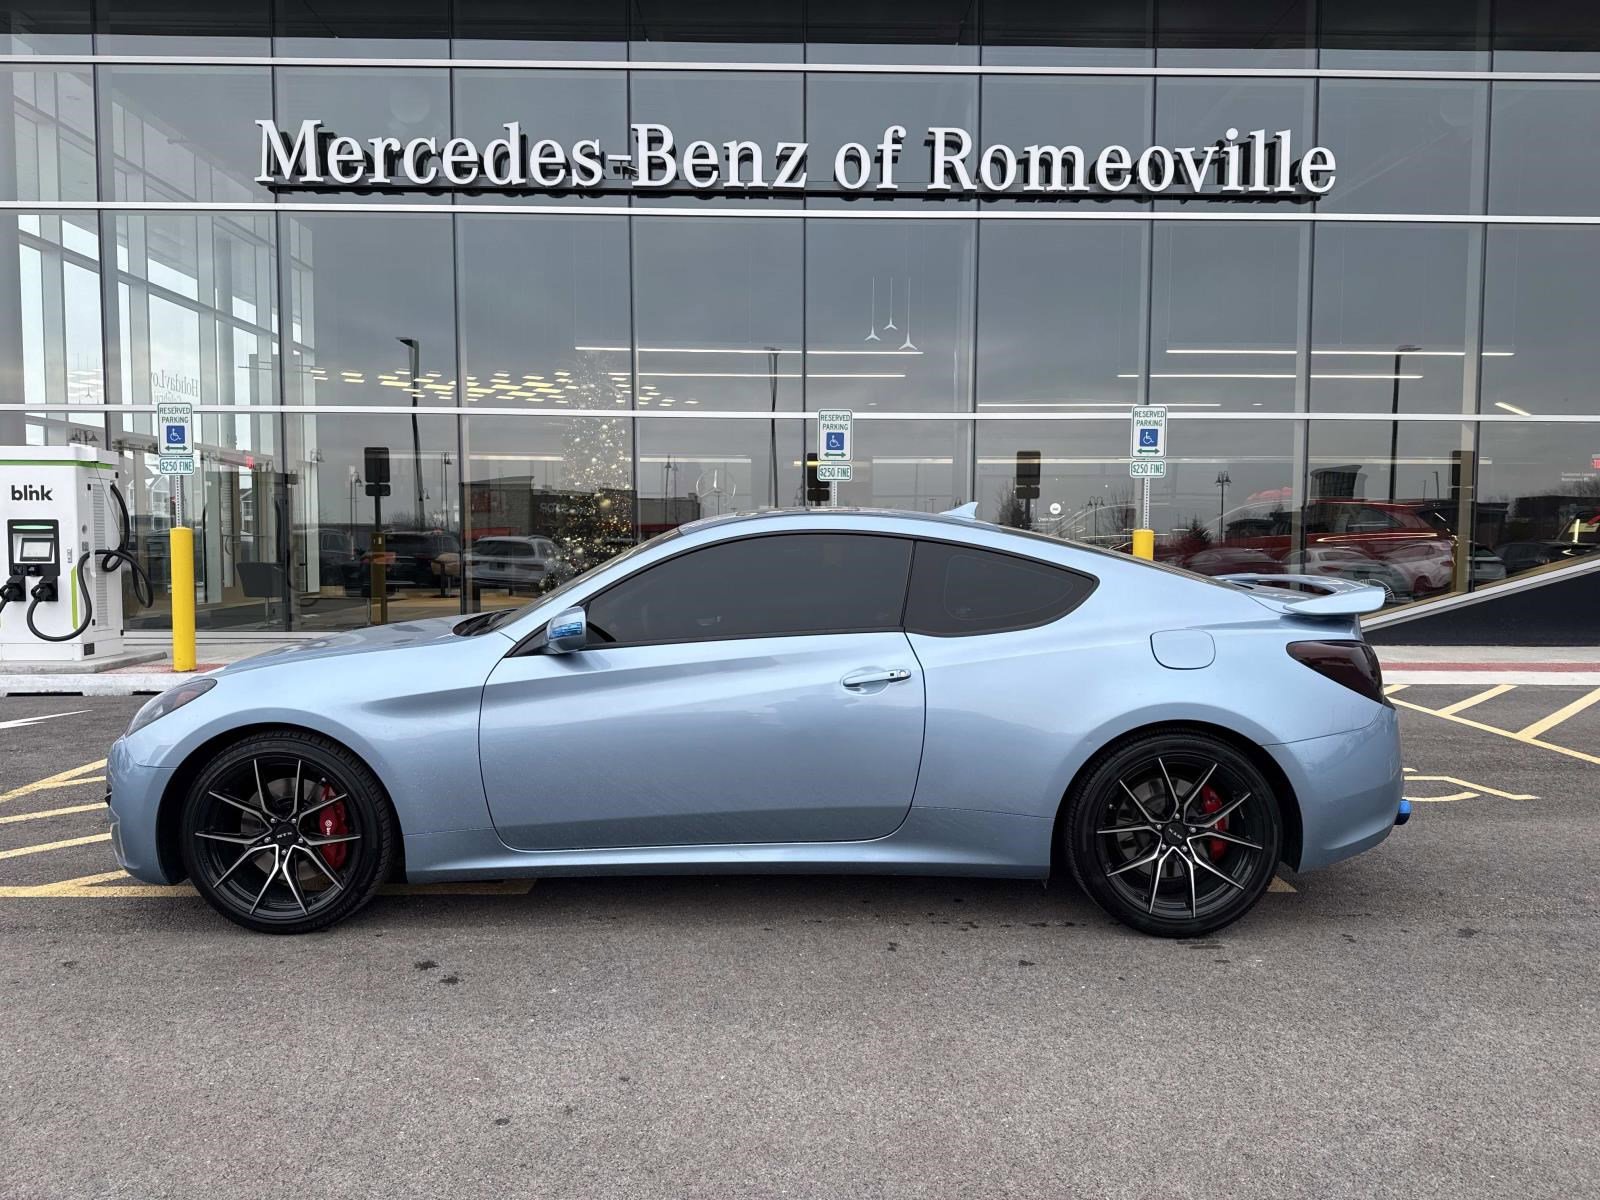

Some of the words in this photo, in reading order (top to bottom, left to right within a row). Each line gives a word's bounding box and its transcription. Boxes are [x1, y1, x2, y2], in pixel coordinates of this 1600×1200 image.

[253, 119, 809, 189] Mercedes-Benz
[834, 125, 907, 191] of
[927, 127, 1337, 193] Romeoville
[159, 407, 191, 415] RESERVED
[1134, 410, 1165, 418] RESERVED
[161, 416, 189, 424] PARKING
[820, 414, 851, 422] RESERVED
[822, 423, 849, 431] PARKING
[1136, 419, 1163, 427] PARKING
[161, 461, 178, 472] $250
[179, 461, 193, 472] FINE
[1132, 463, 1148, 474] $250
[1149, 463, 1164, 474] FINE
[820, 467, 835, 478] $250
[836, 467, 850, 478] FINE
[11, 484, 54, 501] blink
